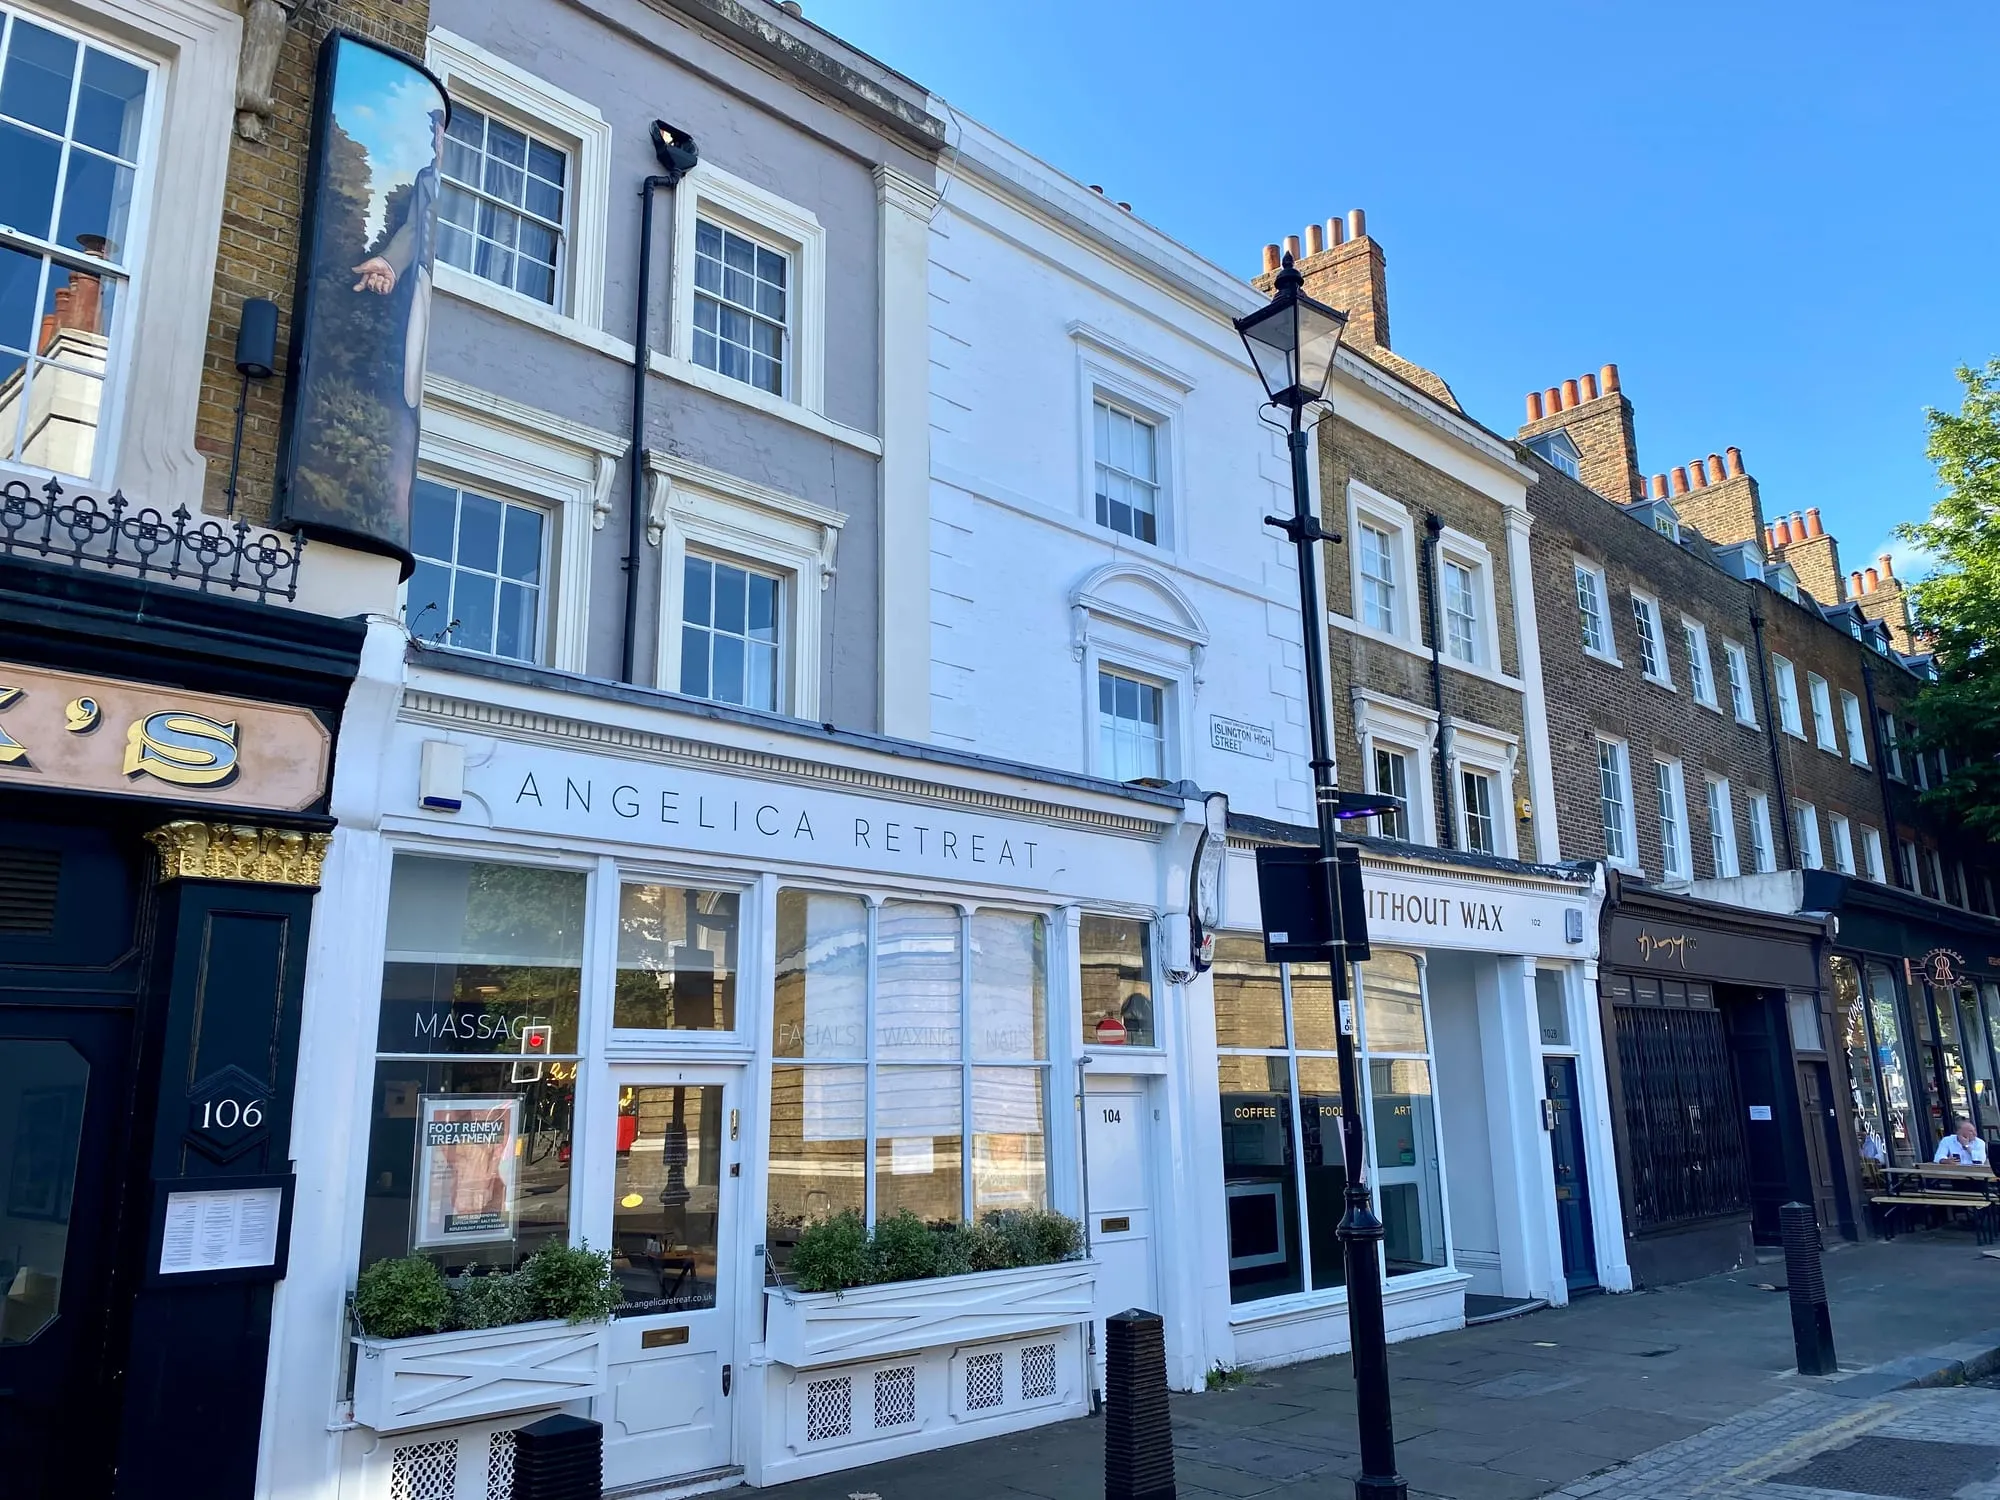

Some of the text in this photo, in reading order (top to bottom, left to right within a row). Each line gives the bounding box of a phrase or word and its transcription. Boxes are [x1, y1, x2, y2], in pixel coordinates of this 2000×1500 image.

[1214, 723, 1252, 742] ISLINGTON
[1254, 733, 1271, 747] HIGH
[1215, 735, 1242, 751] STREET
[515, 771, 1038, 869] ANGELICA RETREAT
[1364, 889, 1503, 932] ITHOUT WAX
[1531, 918, 1541, 926] 102
[882, 1027, 954, 1047] WAXING
[201, 1099, 265, 1129] 106
[1103, 1109, 1121, 1123] 104
[1234, 1107, 1276, 1118] COFFEE
[1394, 1105, 1412, 1116] ART
[428, 1121, 503, 1134] FOOT RENEW
[430, 1133, 498, 1145] TREATMENT
